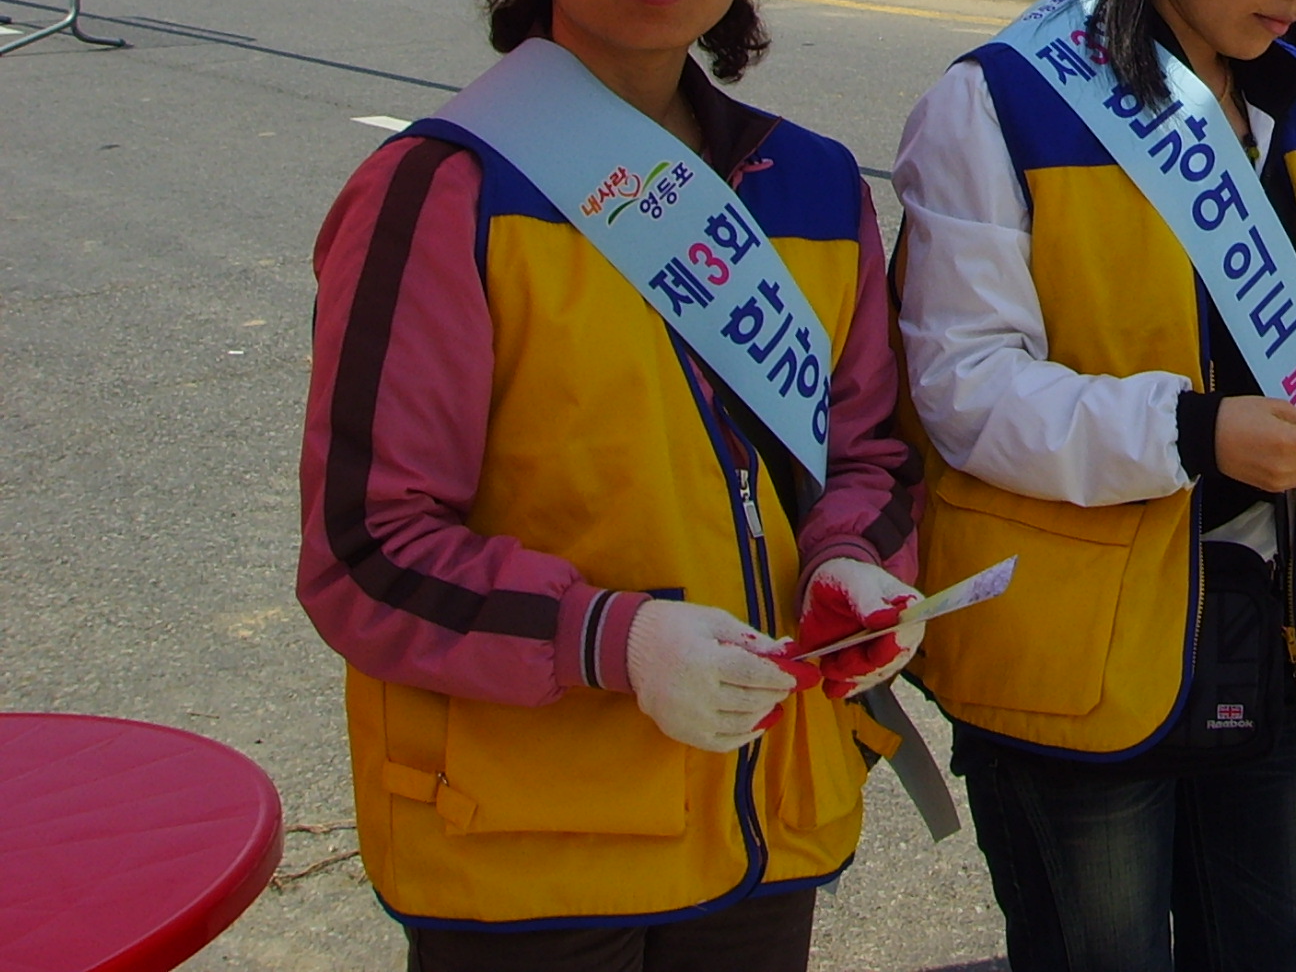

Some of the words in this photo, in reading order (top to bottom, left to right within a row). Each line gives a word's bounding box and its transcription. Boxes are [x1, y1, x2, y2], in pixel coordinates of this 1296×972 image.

[1036, 15, 1110, 86] 제3
[640, 161, 694, 219] 영등포
[649, 203, 761, 317] 제3회
